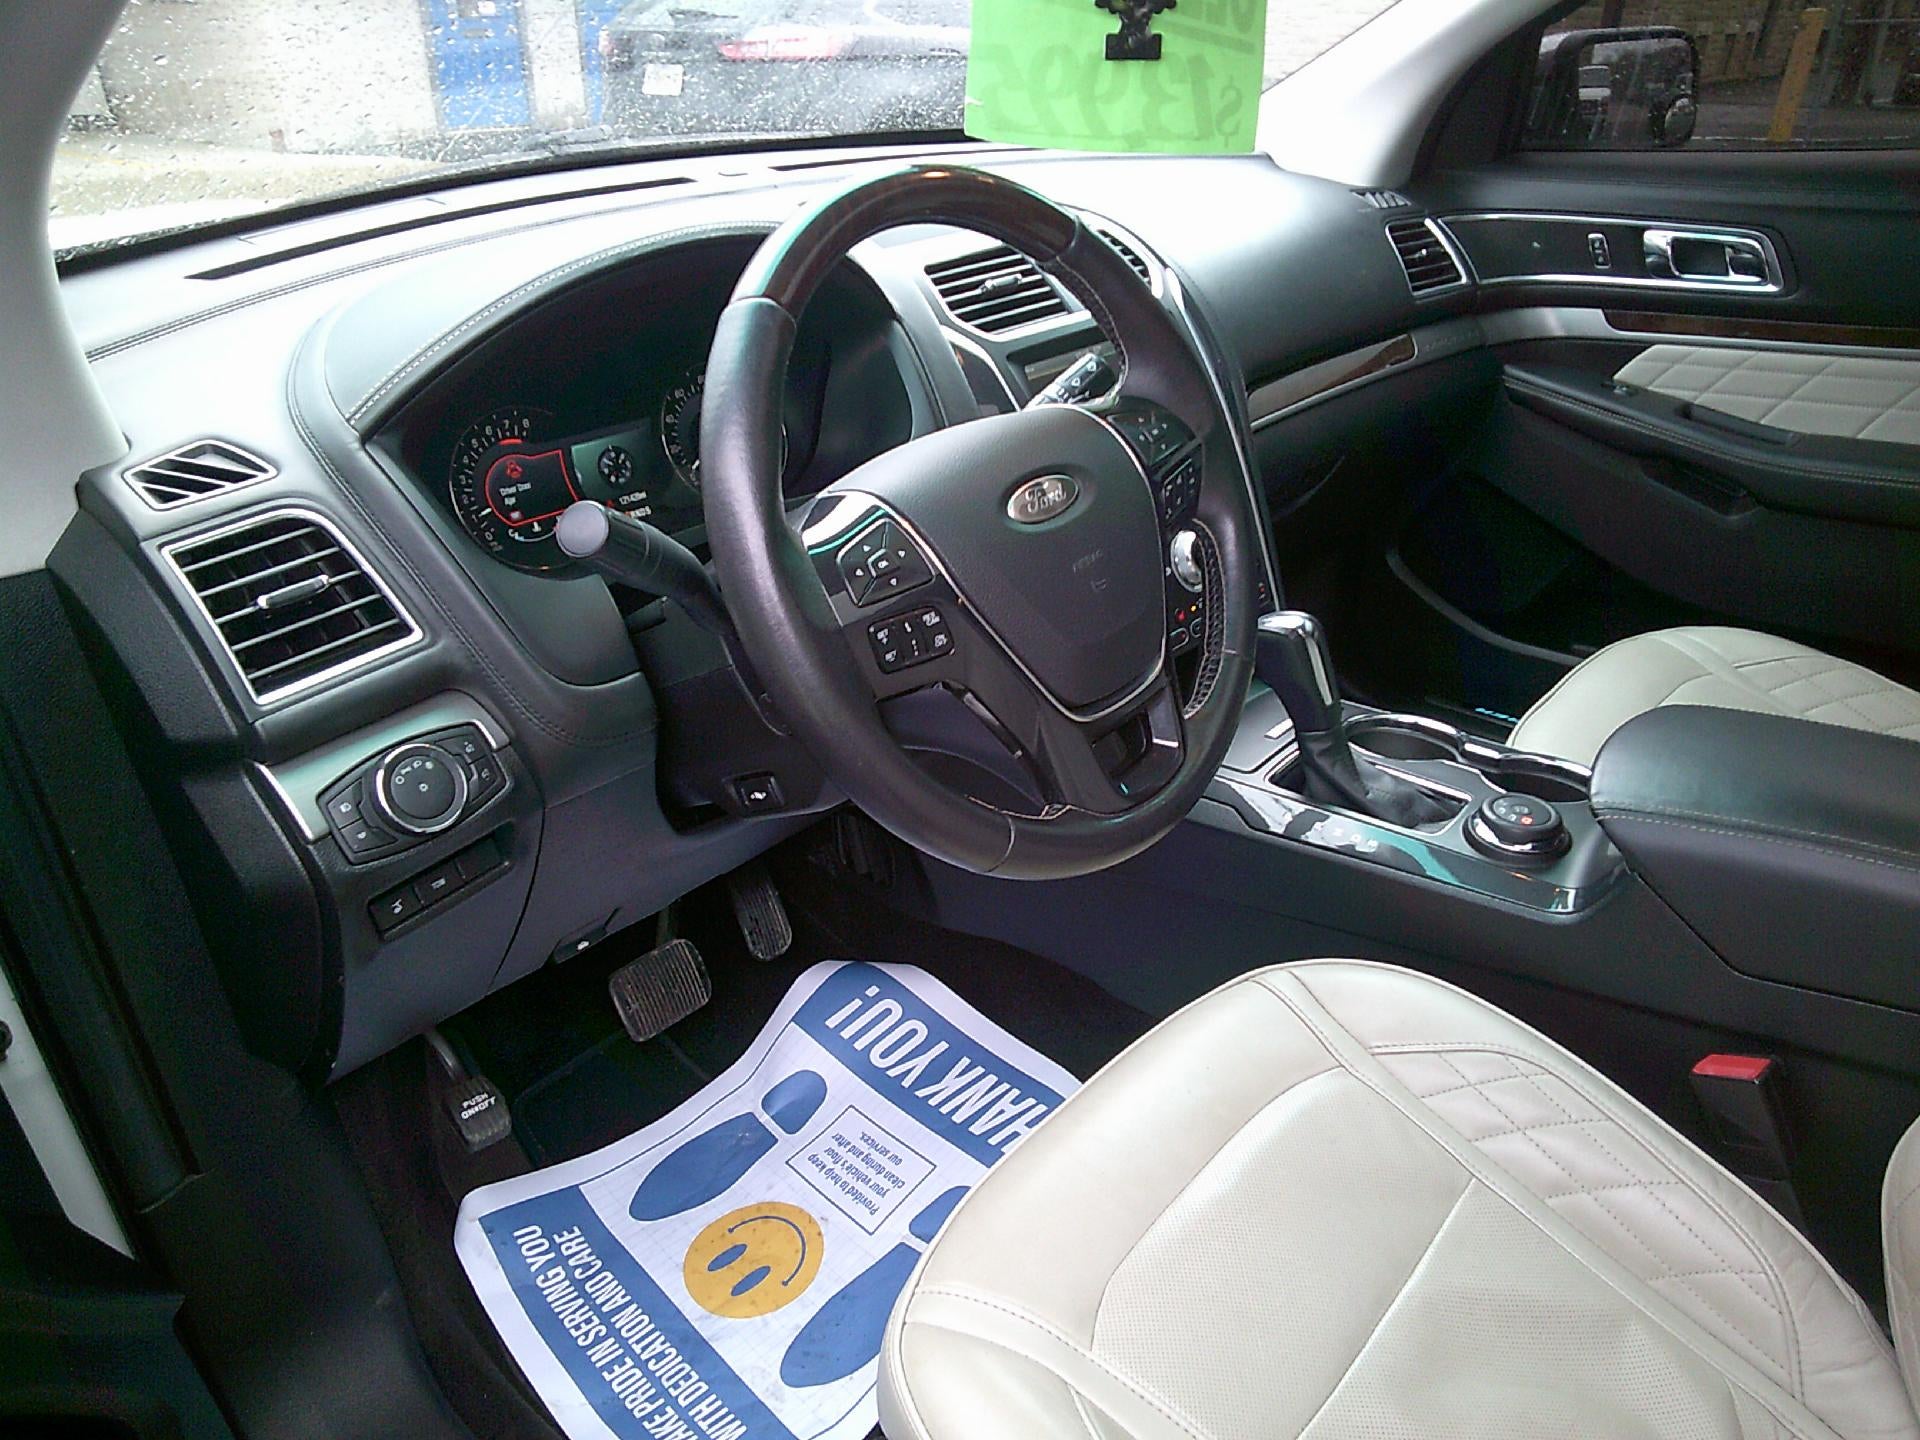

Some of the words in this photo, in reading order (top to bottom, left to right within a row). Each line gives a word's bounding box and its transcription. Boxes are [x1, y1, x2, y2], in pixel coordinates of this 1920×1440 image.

[485, 425, 493, 436] 6
[503, 420, 510, 429] 7
[471, 438, 479, 449] 5
[1025, 480, 1067, 513] Ford
[824, 985, 950, 1089] YOU!
[462, 1093, 489, 1109] PUSH
[914, 1056, 1049, 1153] HANK
[831, 1133, 851, 1149] after
[846, 1144, 865, 1159] and
[859, 1131, 890, 1157] services.
[807, 1153, 827, 1173] keep
[824, 1147, 844, 1165] floor
[860, 1152, 886, 1176] during
[887, 1154, 903, 1166] our
[824, 1167, 843, 1186] help
[840, 1160, 872, 1186] vehicle's
[883, 1170, 906, 1189] clean
[840, 1180, 850, 1193] to
[869, 1182, 891, 1198] your
[845, 1185, 880, 1216] Provided
[512, 1225, 556, 1273] YOU
[553, 1225, 602, 1280] CARE
[584, 1270, 632, 1313] AND
[535, 1265, 607, 1347] SERVING
[586, 1337, 625, 1369] IN
[610, 1303, 709, 1408] DEDICATION
[601, 1356, 665, 1419] PRIDE
[642, 1405, 699, 1440] AKE
[688, 1394, 747, 1440] WITH
